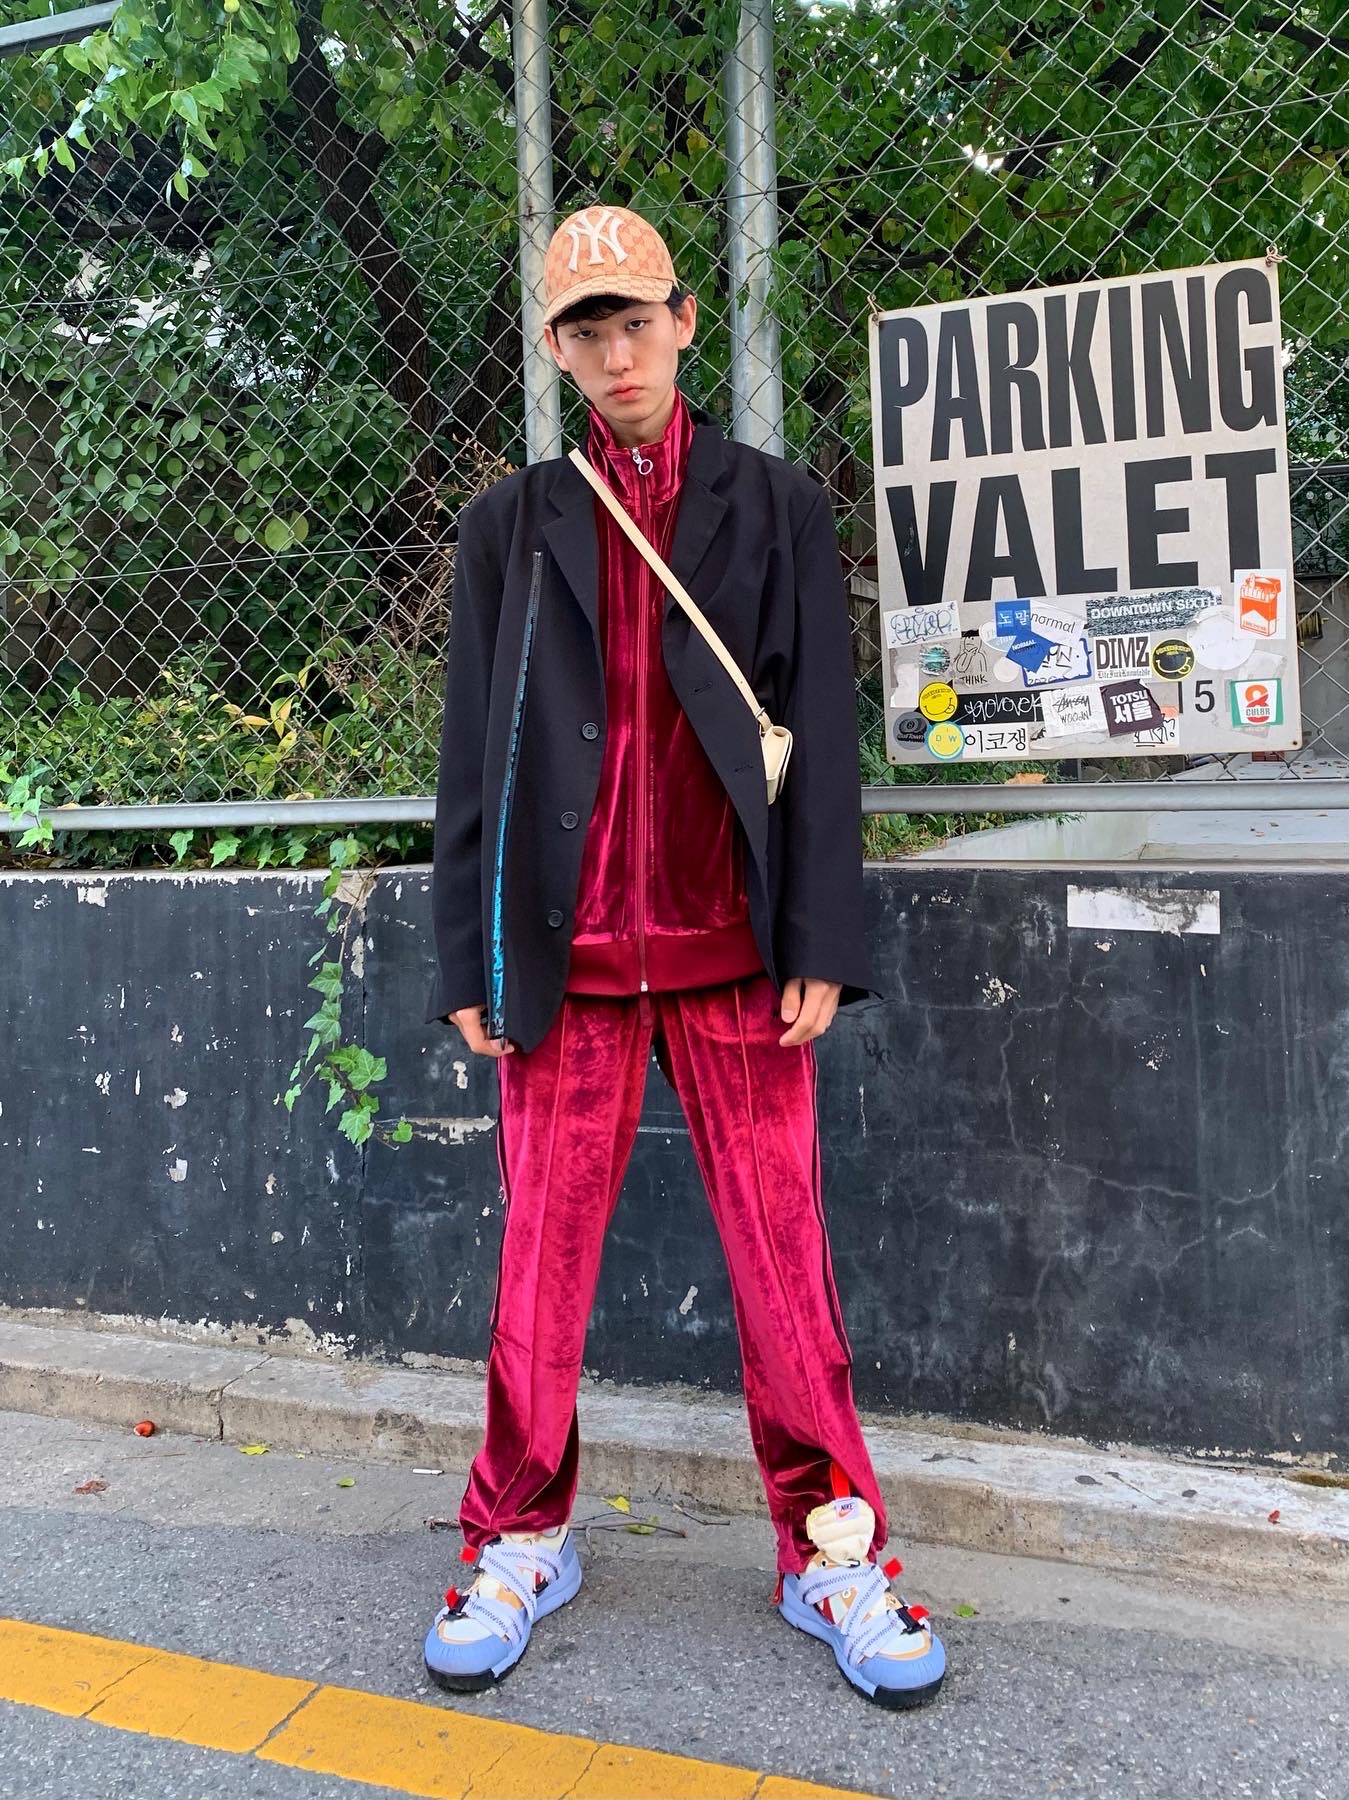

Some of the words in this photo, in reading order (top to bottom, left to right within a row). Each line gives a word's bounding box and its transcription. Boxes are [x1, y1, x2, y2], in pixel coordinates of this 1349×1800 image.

[567, 208, 629, 273] NY
[878, 267, 1278, 467] PARKING
[885, 448, 1277, 606] VALET
[998, 609, 1030, 626] 노말
[1090, 601, 1173, 619] DOWNTOWN
[1176, 596, 1217, 612] SIXTH
[1031, 611, 1076, 634] normal
[1012, 639, 1037, 651] NORMAL
[1095, 636, 1150, 669] DIMZ
[959, 674, 988, 685] THINK
[1110, 689, 1148, 707] TOTSU
[1114, 700, 1153, 724] 서울
[965, 727, 1027, 754] 이코쟁
[841, 1502, 855, 1511] NIKE
